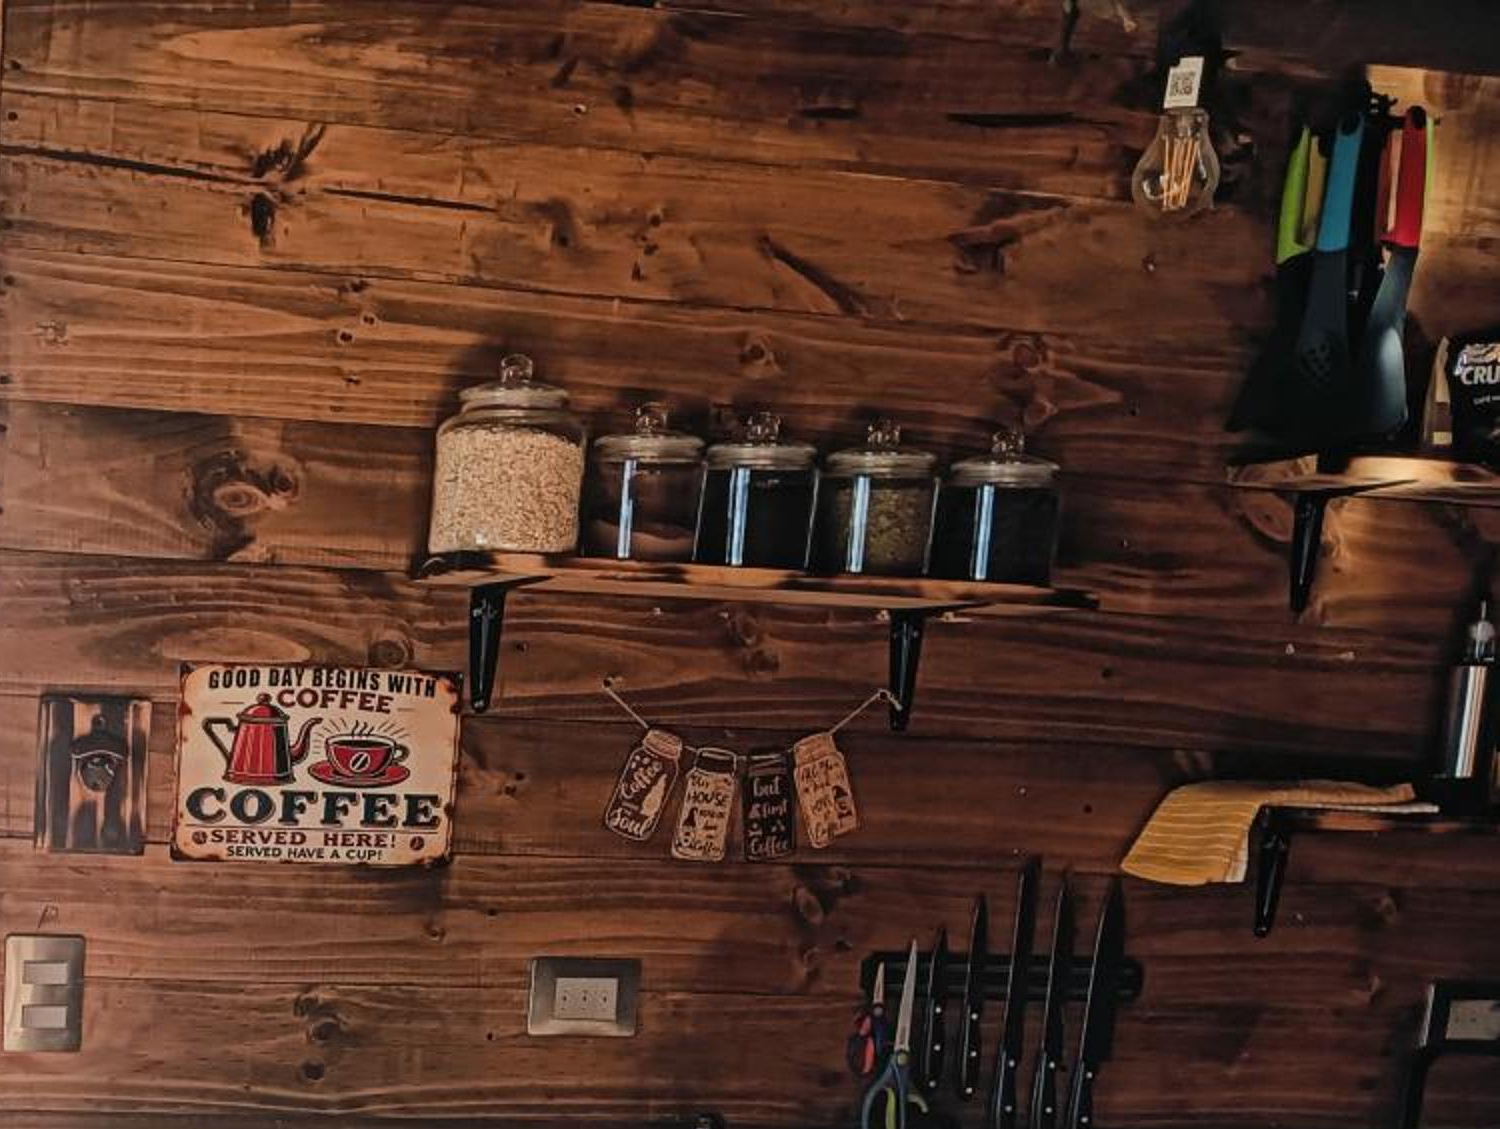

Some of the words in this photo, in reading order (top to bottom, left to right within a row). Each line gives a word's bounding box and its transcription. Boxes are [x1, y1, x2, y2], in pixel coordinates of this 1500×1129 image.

[208, 669, 261, 689] GOOD
[268, 668, 305, 687] DAY
[312, 668, 381, 691] BEGINS
[387, 673, 437, 698] WITH
[277, 688, 394, 714] COFFEE
[621, 761, 663, 799] Coffee
[185, 787, 442, 829] COFFEE
[211, 830, 307, 847] SERVED
[323, 833, 396, 849] HERE!
[227, 846, 282, 858] SERVED
[288, 847, 324, 859] HAVE
[330, 849, 340, 859] A
[346, 849, 383, 861] CUP!
